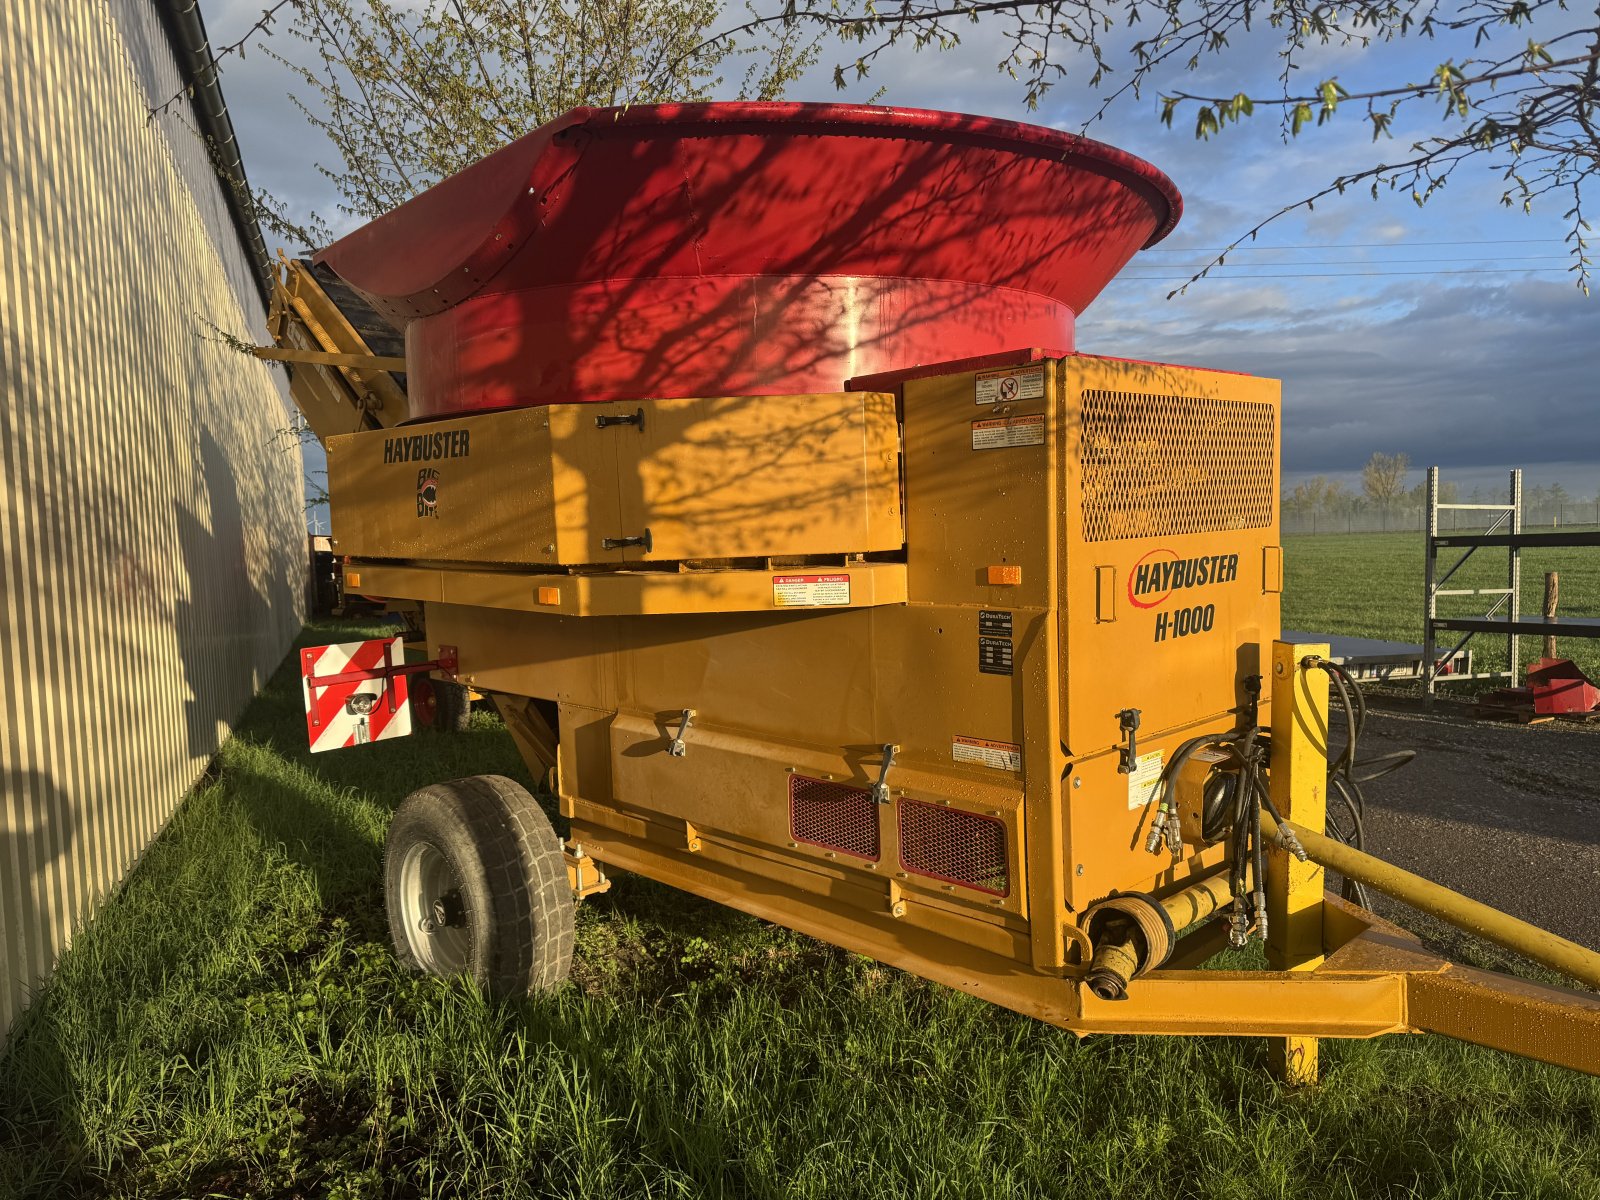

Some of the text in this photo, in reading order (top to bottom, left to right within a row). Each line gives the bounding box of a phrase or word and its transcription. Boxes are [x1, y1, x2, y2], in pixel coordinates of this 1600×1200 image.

[384, 429, 470, 464] HAYBUSTER
[417, 468, 440, 490] BIG
[1134, 553, 1239, 596] HAYBUSTER
[1154, 603, 1215, 643] H-1000
